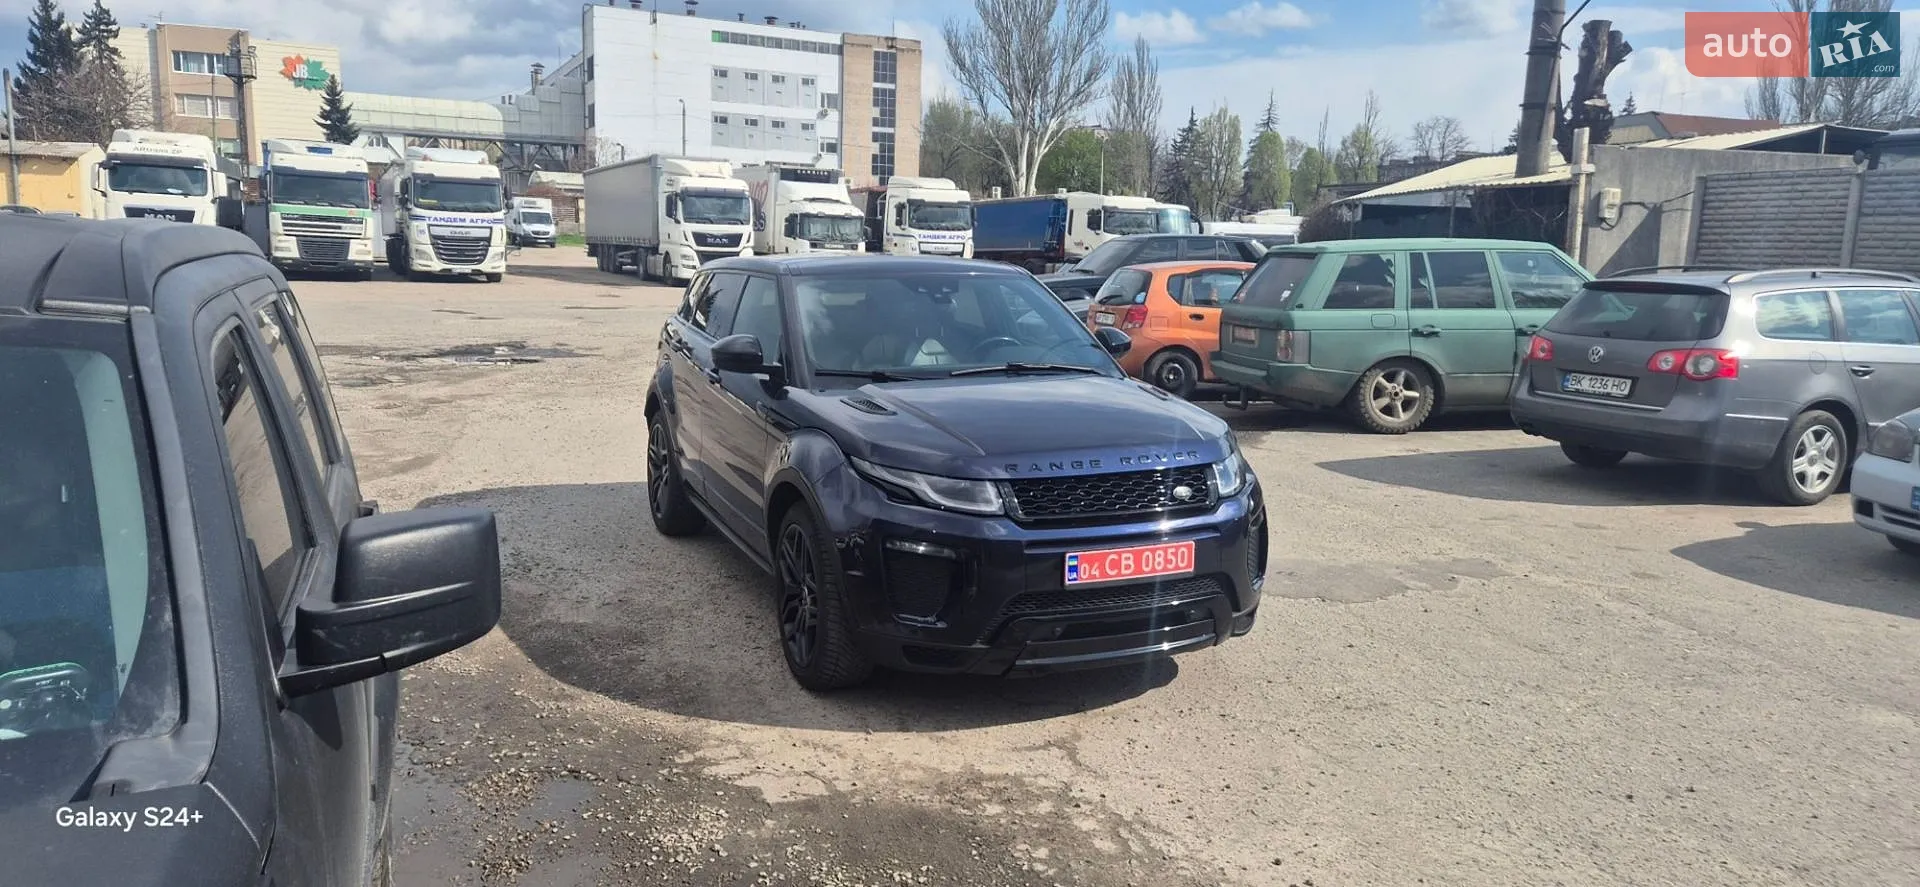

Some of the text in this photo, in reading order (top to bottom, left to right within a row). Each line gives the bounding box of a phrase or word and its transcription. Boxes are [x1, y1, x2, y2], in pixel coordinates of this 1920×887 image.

[292, 63, 308, 78] JB
[144, 213, 176, 221] MAN
[1570, 375, 1585, 387] BK
[1588, 376, 1609, 390] 1236
[1004, 450, 1200, 474] RANGE ROVER
[1080, 547, 1189, 579] 04 CB 0850
[1067, 571, 1078, 581] UA
